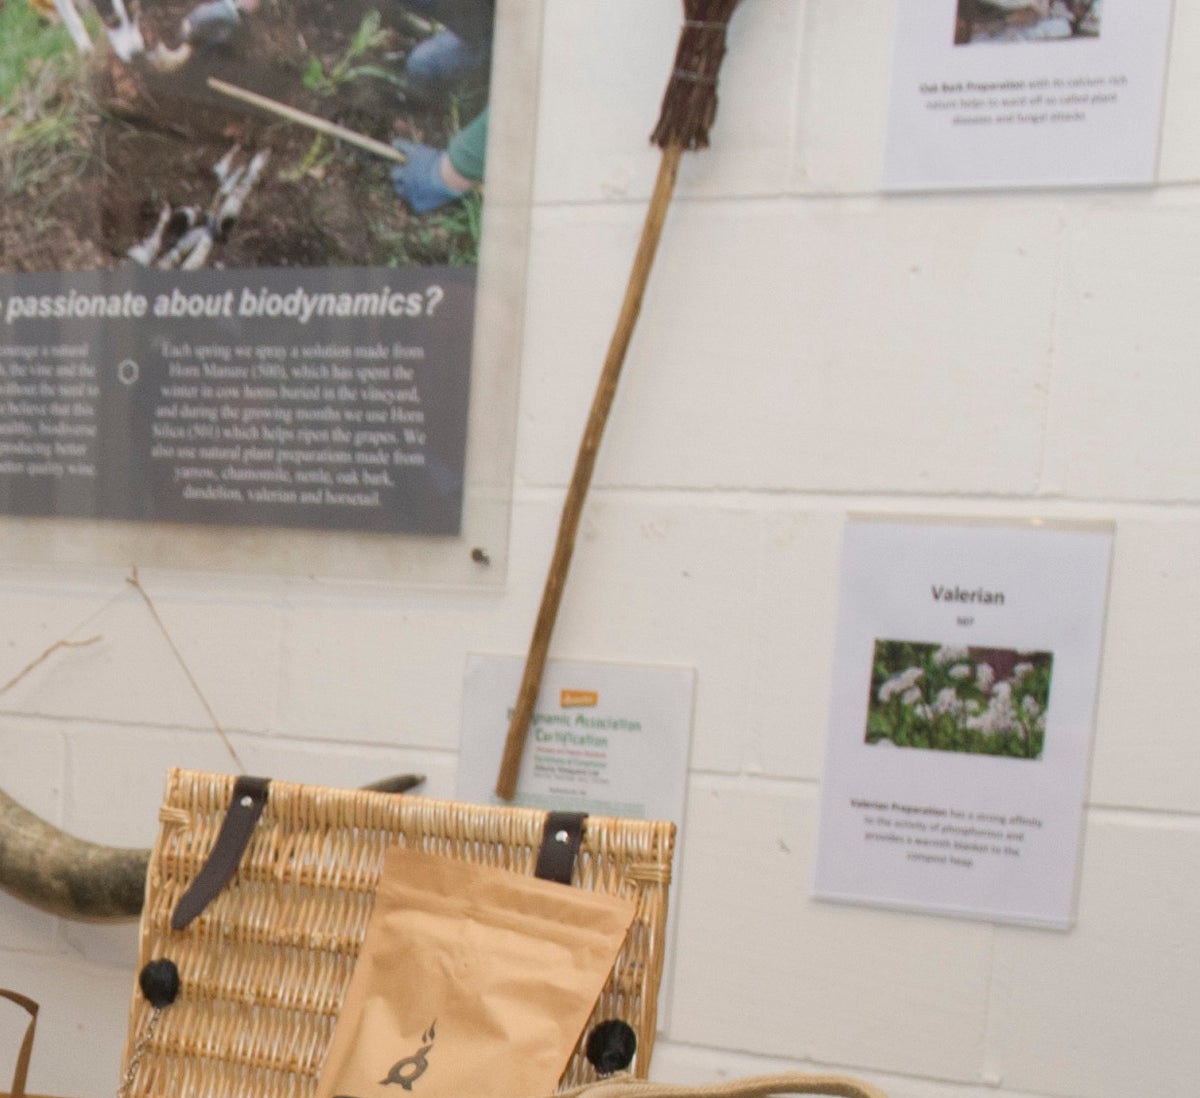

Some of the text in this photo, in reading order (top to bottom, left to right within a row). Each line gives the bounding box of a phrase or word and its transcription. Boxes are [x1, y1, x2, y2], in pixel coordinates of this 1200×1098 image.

[6, 289, 147, 324] passionate
[154, 288, 234, 318] about
[240, 284, 444, 322] biodynamics?
[354, 345, 389, 359] made
[392, 344, 425, 359] from
[931, 584, 1006, 606] Valerian
[574, 712, 641, 731] Association
[535, 728, 608, 747] Certification
[891, 803, 947, 818] Preparation
